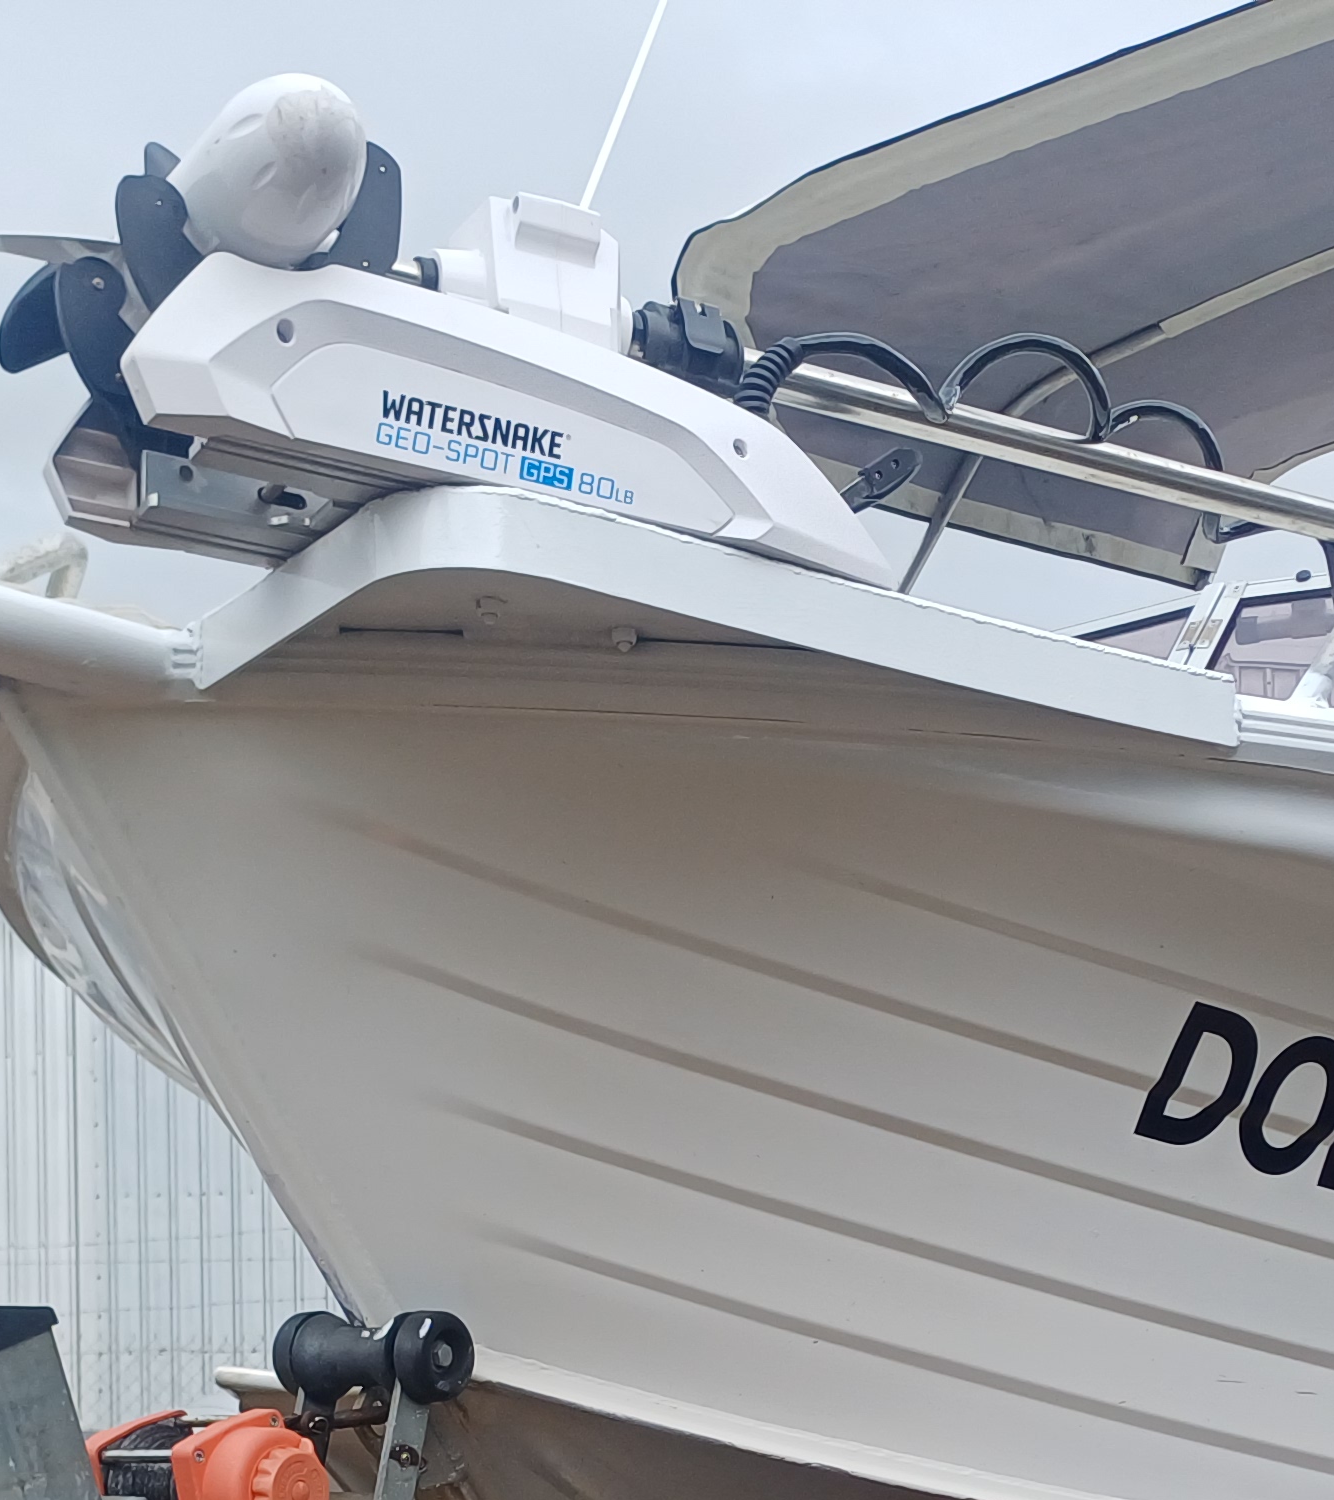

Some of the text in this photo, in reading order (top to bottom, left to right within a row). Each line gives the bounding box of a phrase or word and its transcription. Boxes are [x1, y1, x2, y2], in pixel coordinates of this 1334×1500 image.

[375, 421, 516, 475] GEO-SPOT
[522, 459, 570, 489] GPS
[381, 389, 565, 460] WATERSNAKE
